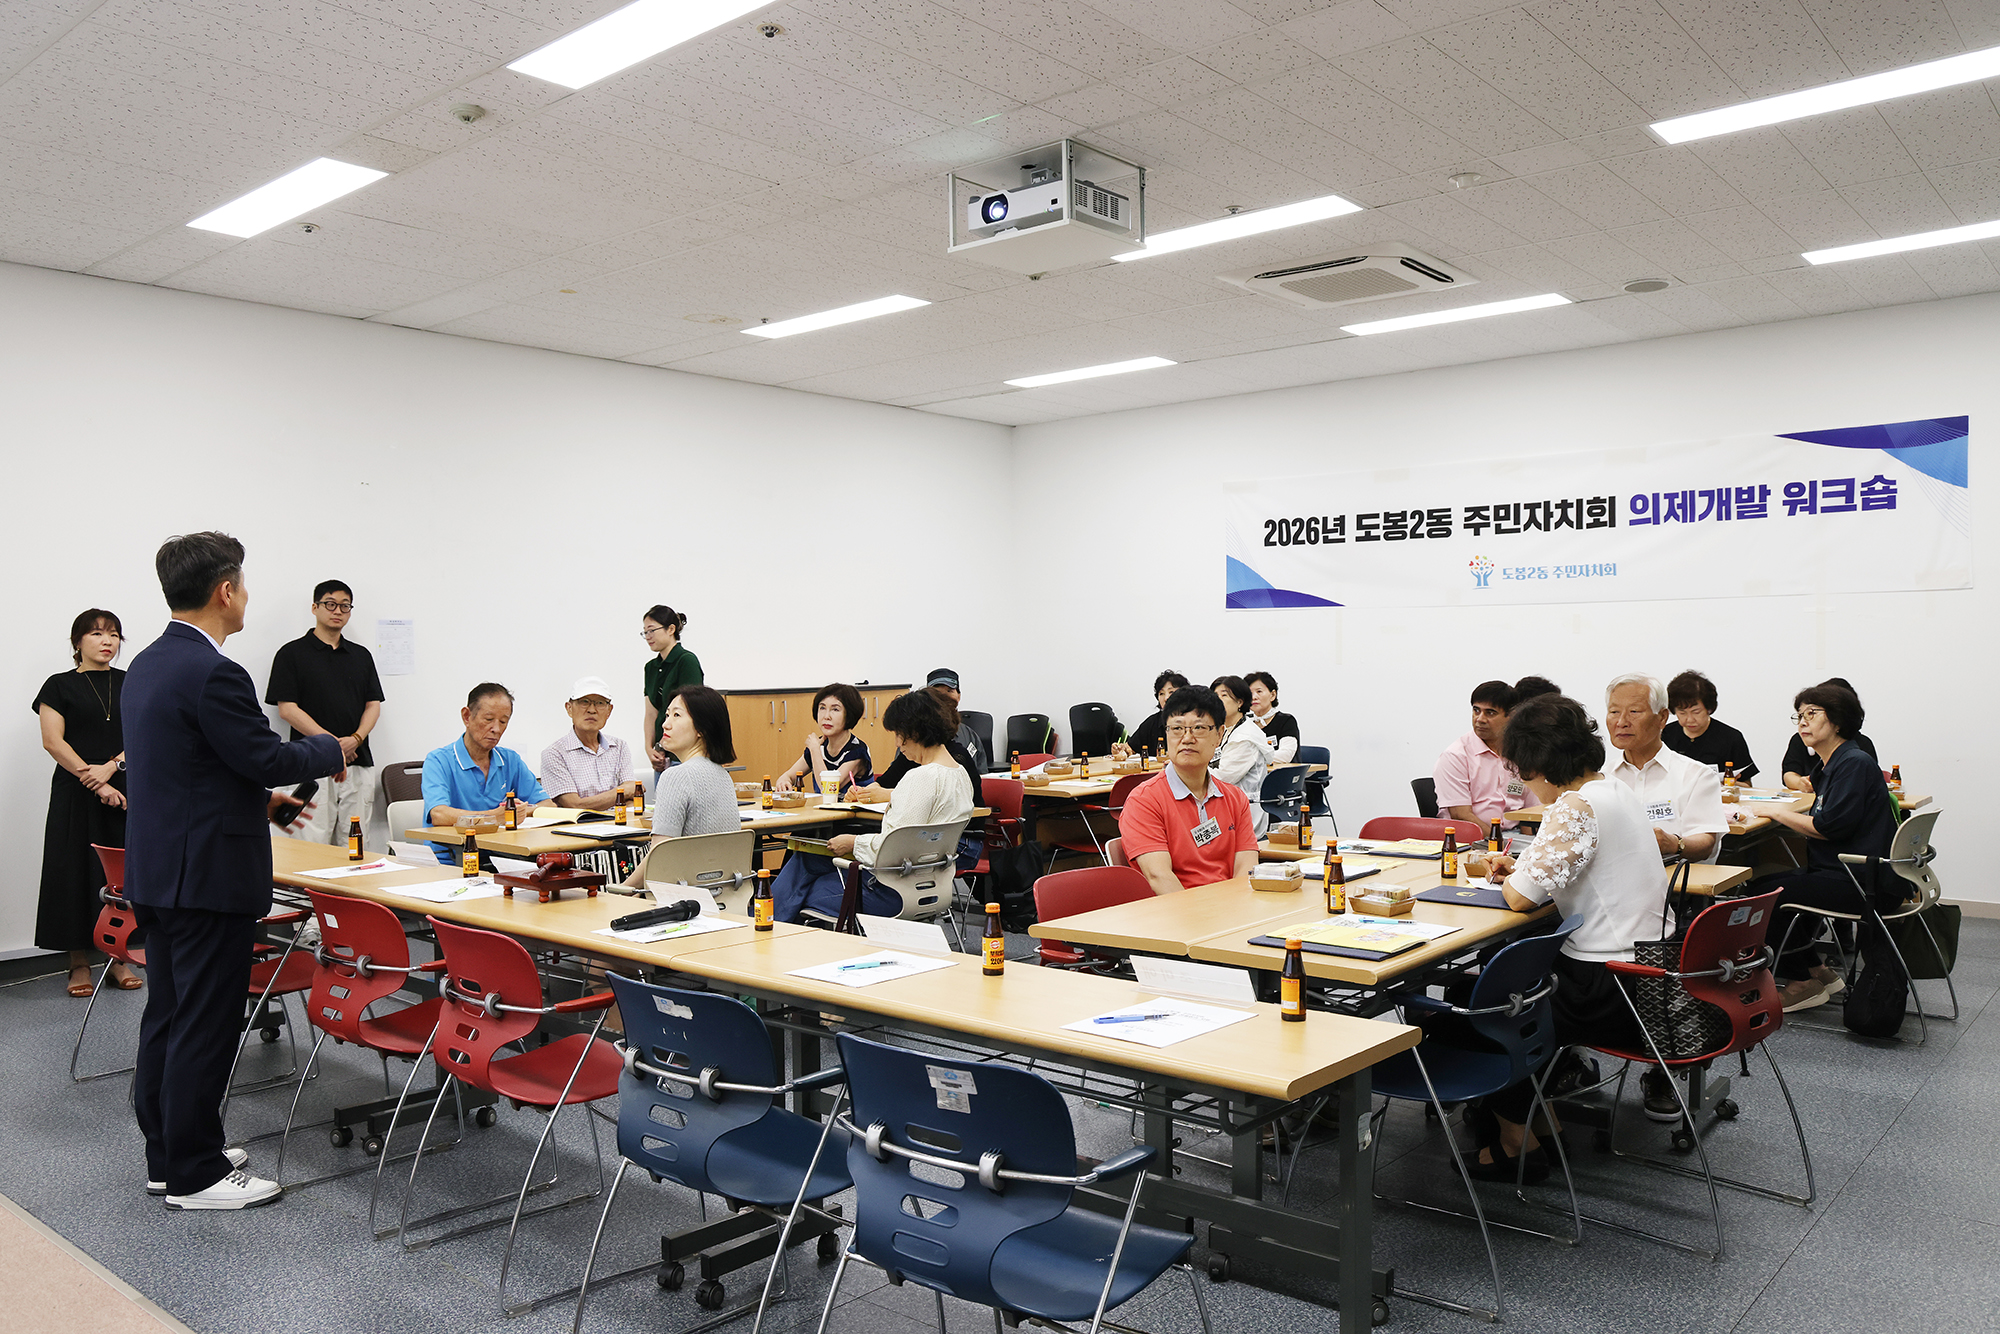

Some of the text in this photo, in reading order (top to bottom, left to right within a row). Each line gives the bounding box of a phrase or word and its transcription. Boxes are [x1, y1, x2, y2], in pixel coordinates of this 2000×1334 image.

[1264, 474, 1898, 547] 2026년 도봉2동 주민자치회 의제개발 워크숍
[1502, 563, 1617, 581] 도봉2동 주민자치회
